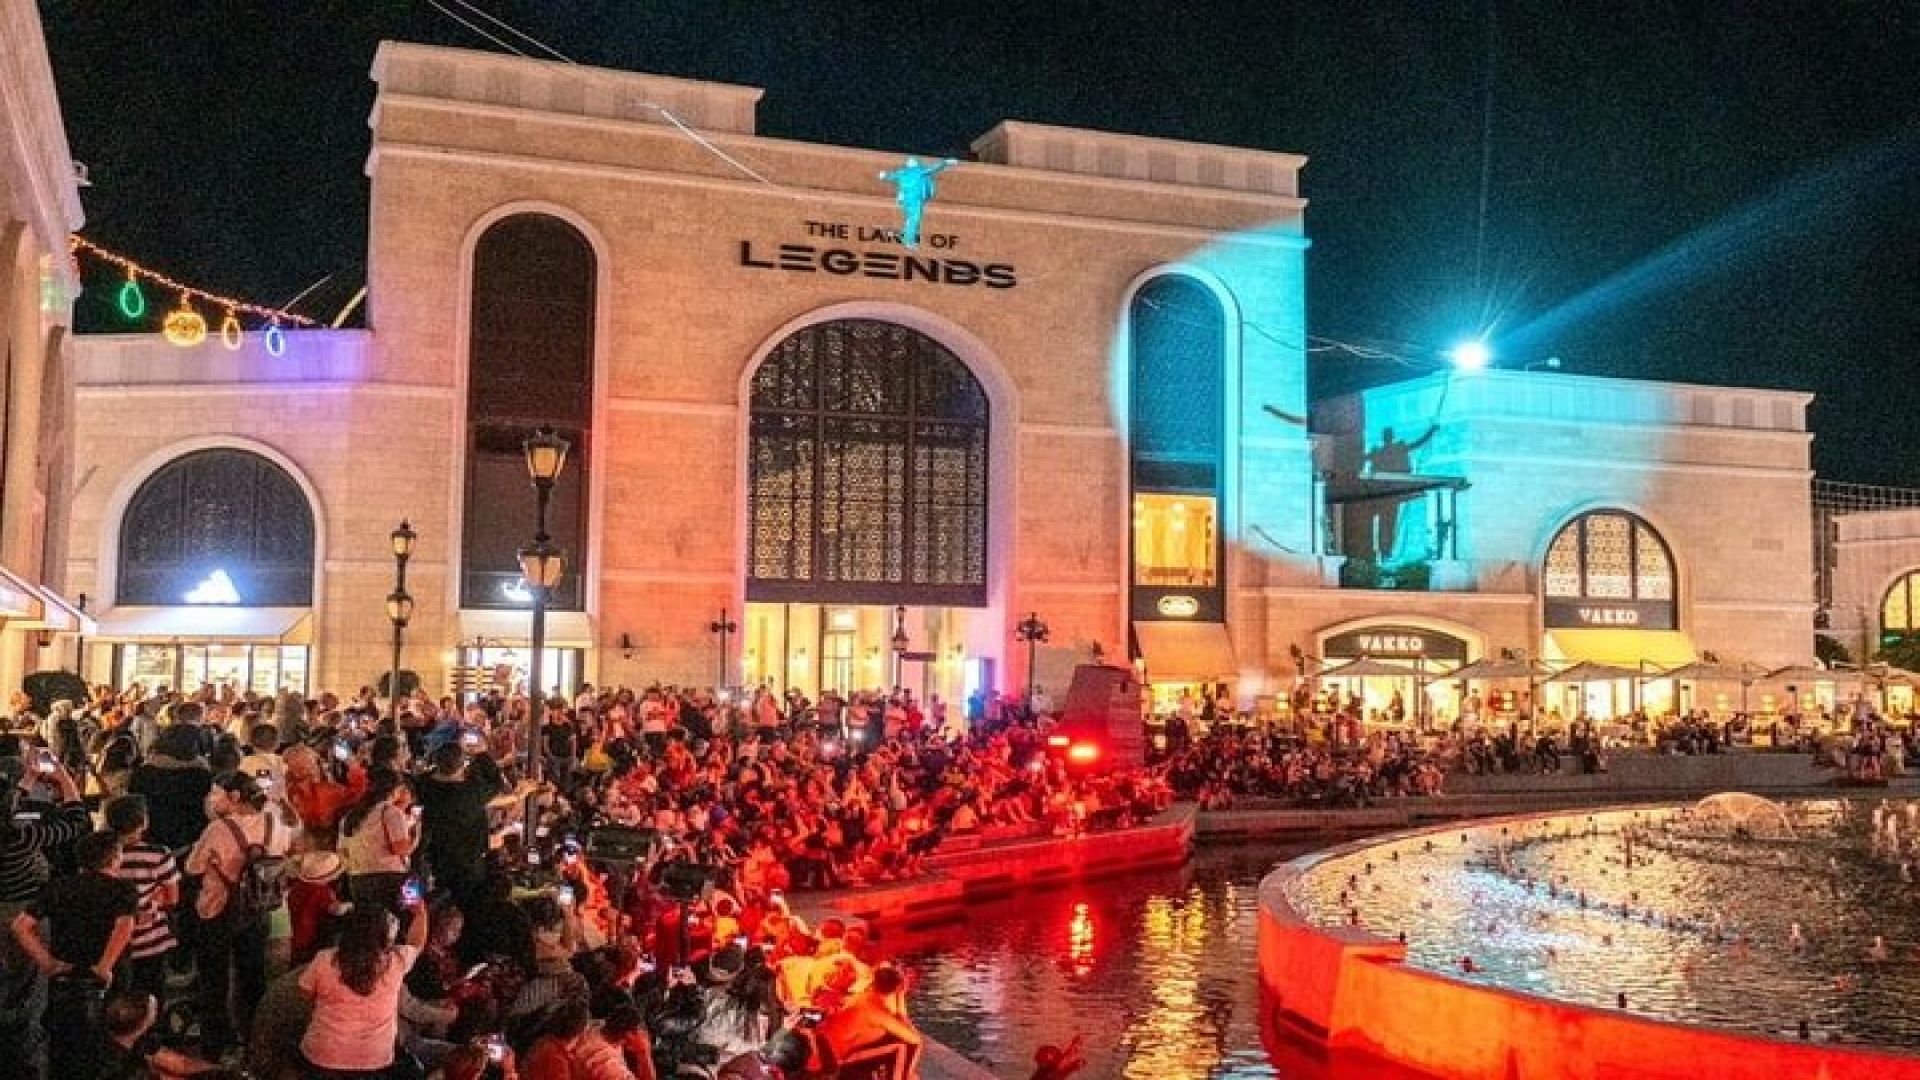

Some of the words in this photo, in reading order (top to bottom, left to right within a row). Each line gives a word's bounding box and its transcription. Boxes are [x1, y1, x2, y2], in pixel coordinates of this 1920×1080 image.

[804, 220, 849, 239] THE
[930, 234, 959, 249] OF
[739, 240, 1017, 289] LEGENDS
[1579, 608, 1638, 624] VAKKO
[1359, 635, 1423, 651] VAKKO
